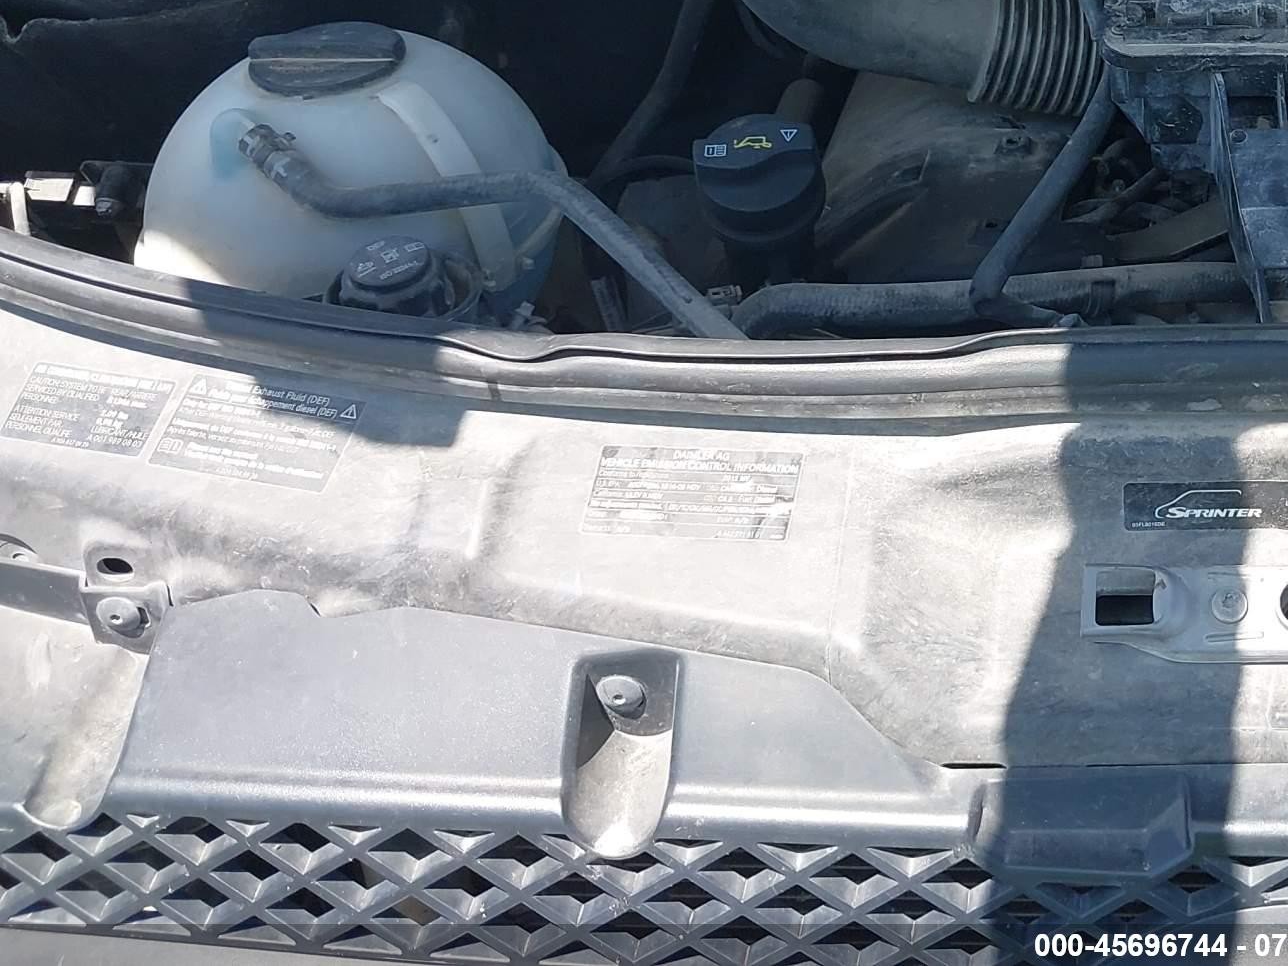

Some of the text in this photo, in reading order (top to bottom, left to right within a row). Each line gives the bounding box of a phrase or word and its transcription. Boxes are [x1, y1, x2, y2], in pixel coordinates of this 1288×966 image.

[252, 386, 286, 398] Exhaust
[286, 391, 308, 401] Fluid
[306, 395, 331, 407] (DEF)
[295, 404, 318, 414] diesel
[317, 408, 338, 418] (DEF)
[673, 450, 731, 461] DAIMLER AG
[601, 458, 640, 467] VEHICLE
[687, 461, 732, 471] CONTROL
[733, 463, 799, 473] INFORMATION
[1166, 506, 1263, 519] SPRINTER
